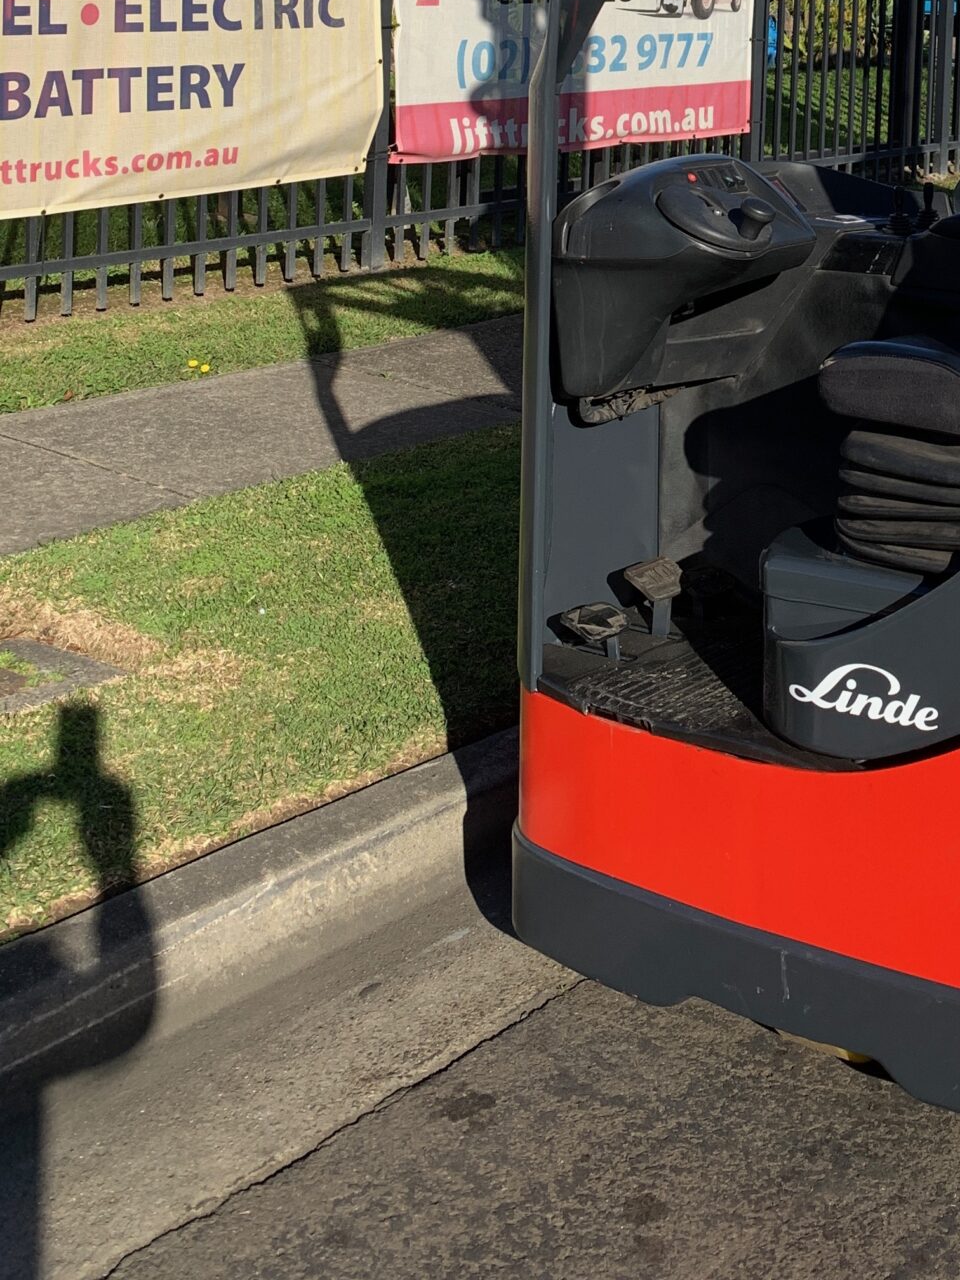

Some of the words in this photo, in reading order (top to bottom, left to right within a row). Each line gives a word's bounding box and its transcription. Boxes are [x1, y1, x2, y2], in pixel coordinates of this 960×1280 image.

[456, 37, 531, 89] (02)
[637, 32, 714, 70] 9777
[0, 62, 245, 120] BATTERY
[450, 105, 714, 155] lifttrks.com.au
[789, 663, 939, 731] Linde
